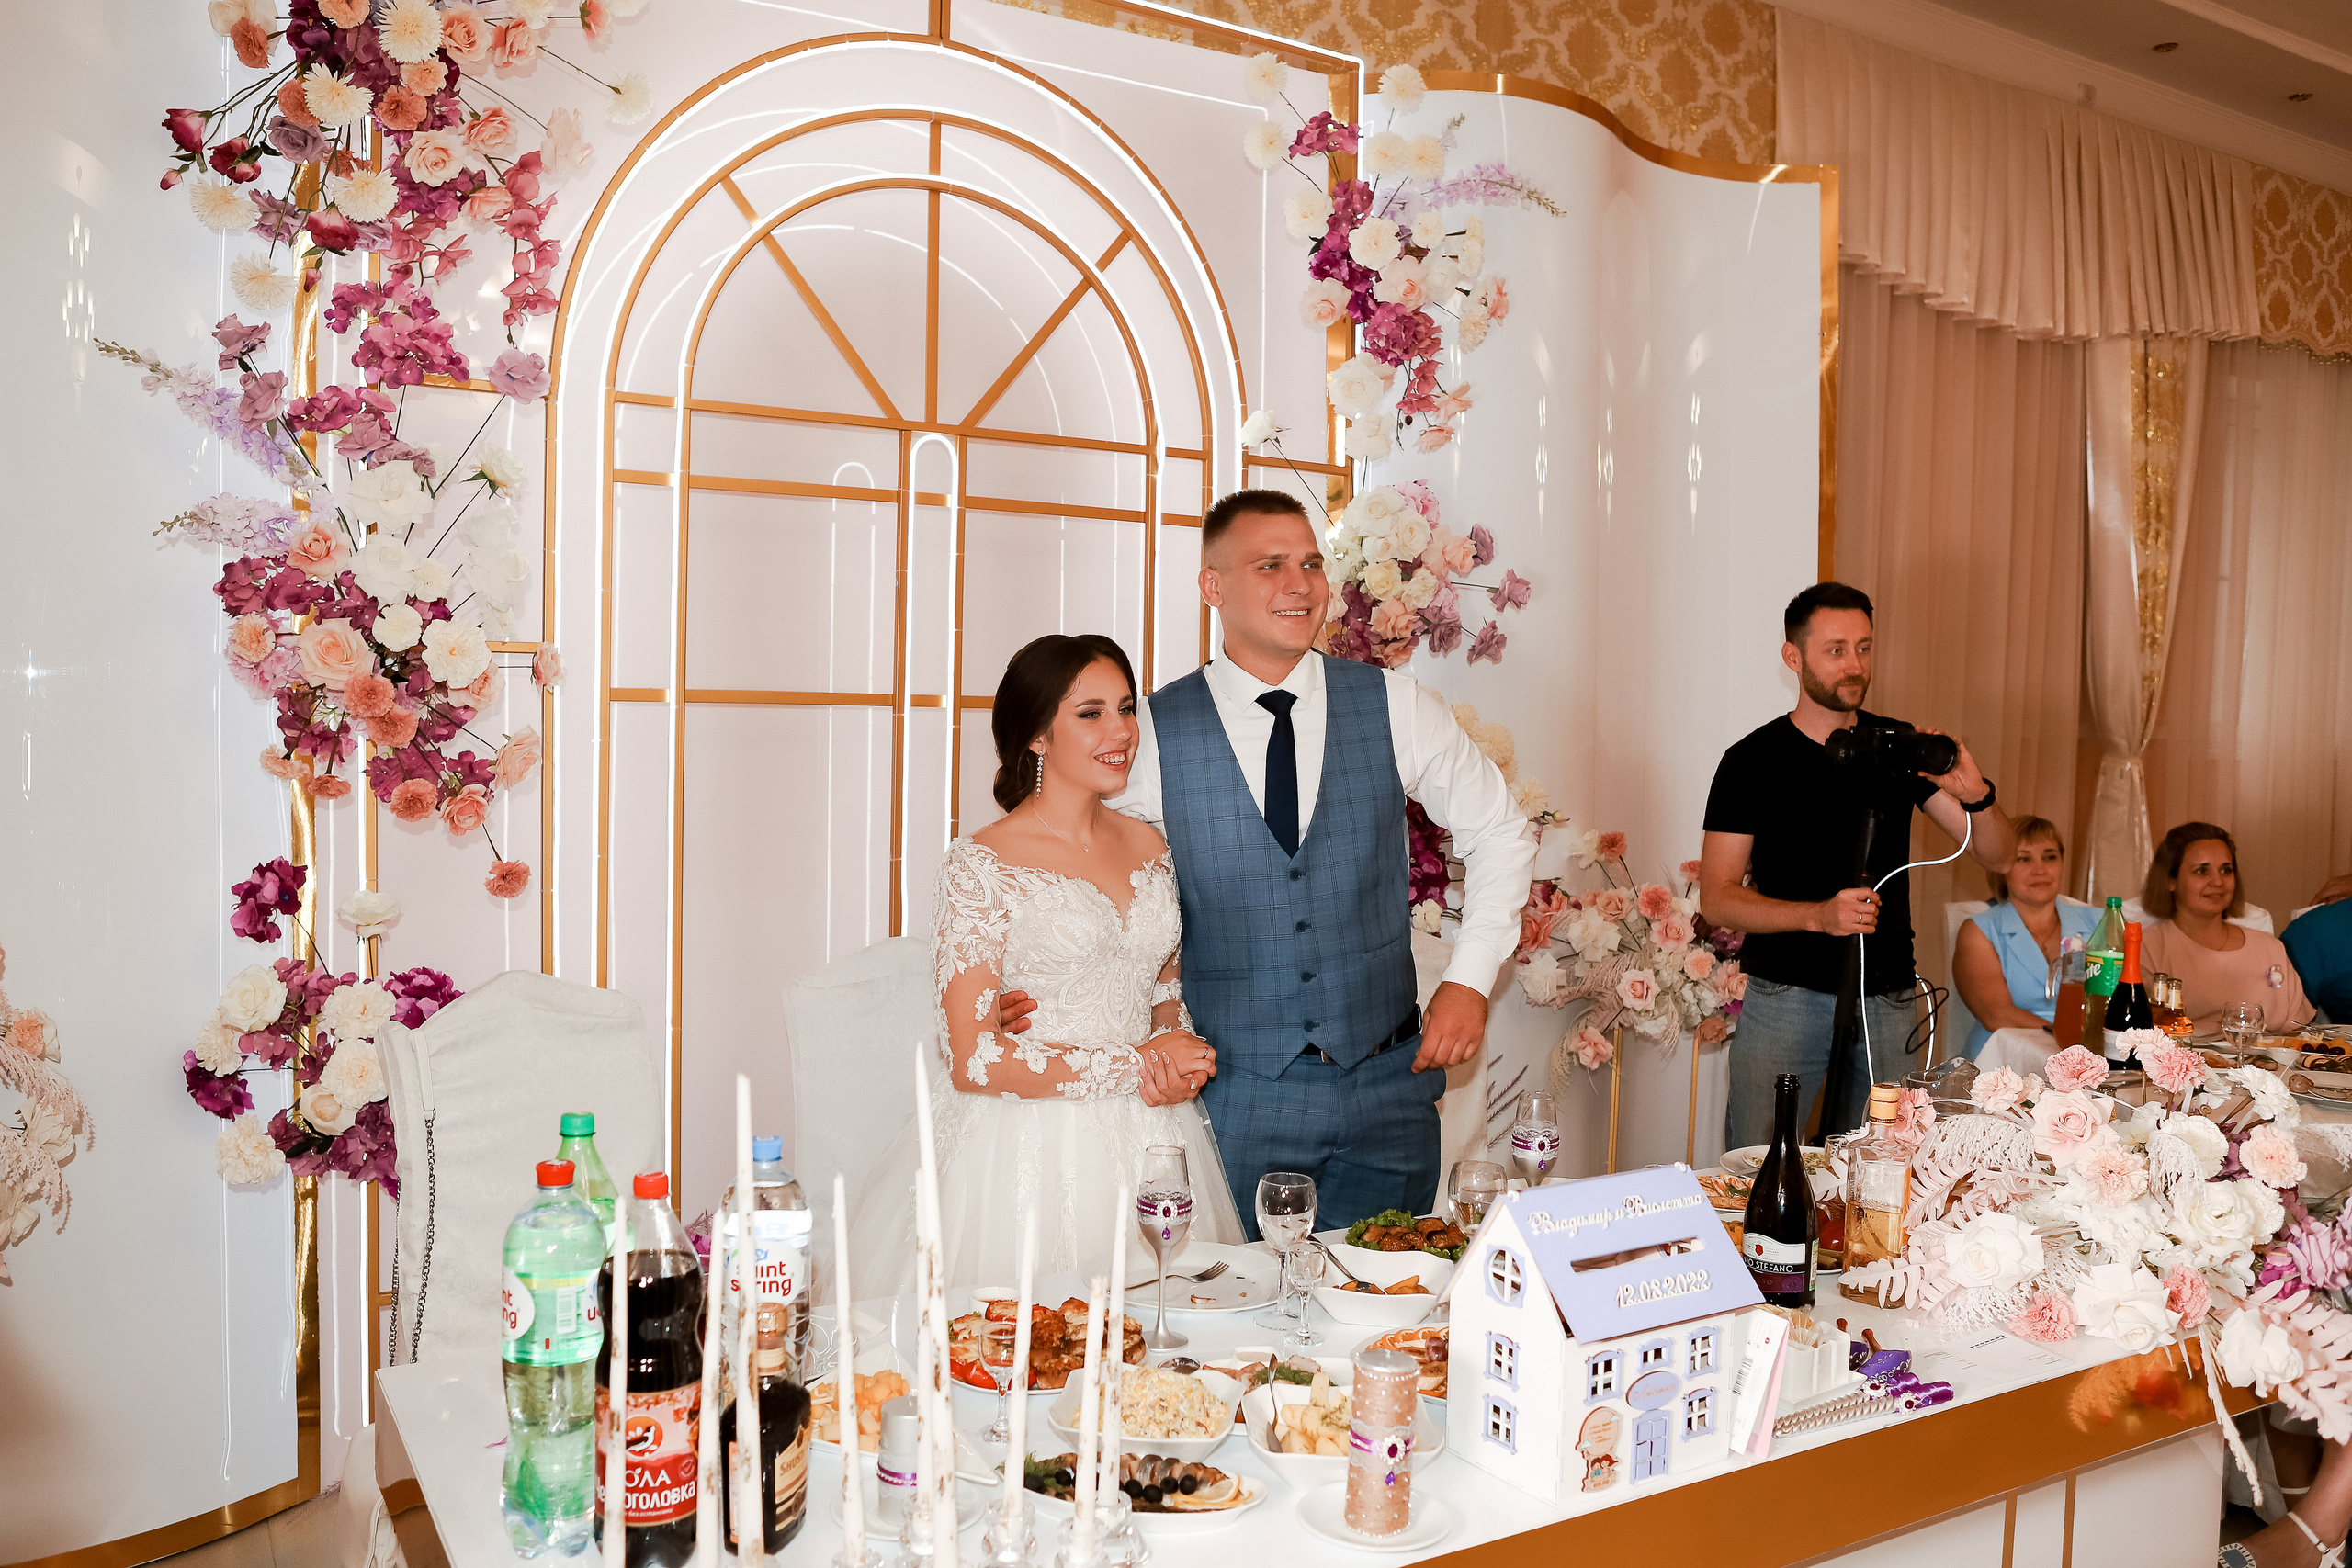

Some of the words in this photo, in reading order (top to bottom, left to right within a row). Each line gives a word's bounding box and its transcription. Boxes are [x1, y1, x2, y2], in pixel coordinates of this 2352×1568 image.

[1528, 1208, 1612, 1237] Владимир
[1613, 1211, 1625, 1221] и
[1623, 1194, 1704, 1219] Виолетта
[1756, 1259, 1793, 1273] STEFANO
[1615, 1269, 1711, 1309] 12.08.2022
[595, 1475, 696, 1510] Чеоголовка
[626, 1467, 672, 1488] ОЛА
